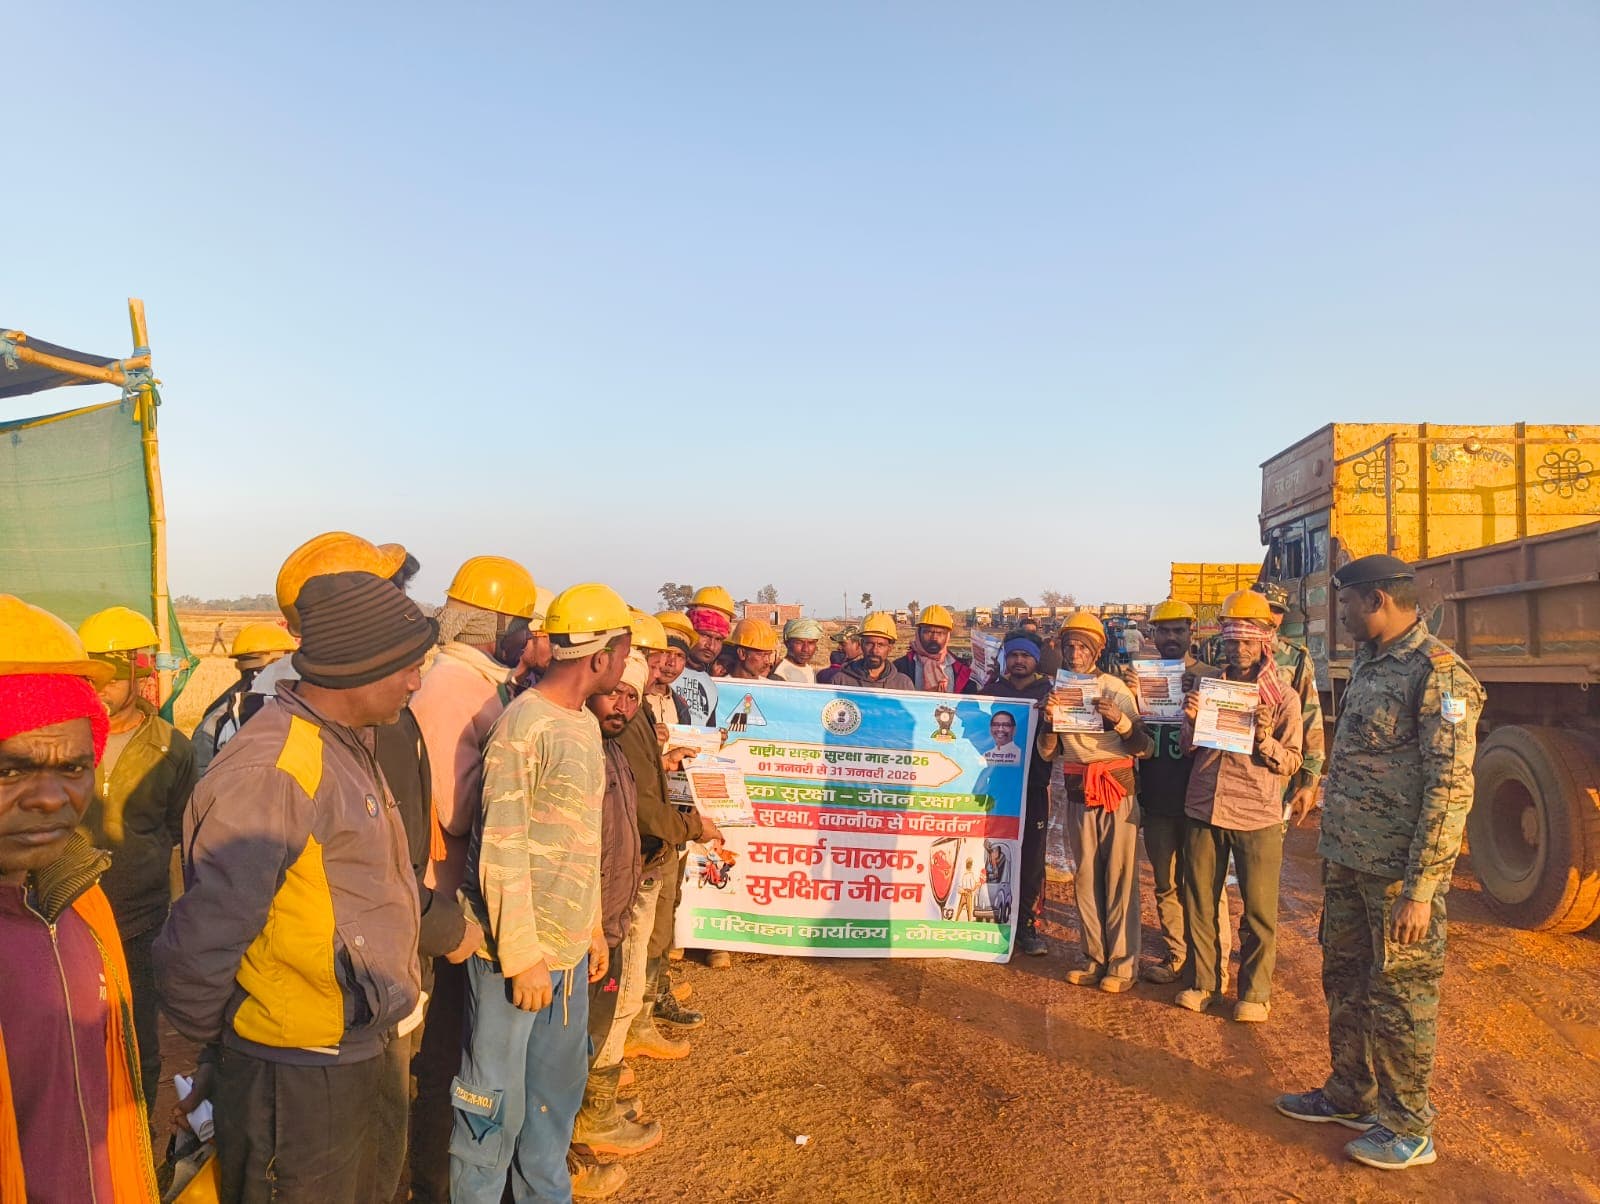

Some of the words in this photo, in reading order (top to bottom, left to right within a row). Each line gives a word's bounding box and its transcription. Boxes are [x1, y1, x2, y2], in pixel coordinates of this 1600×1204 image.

[683, 677, 698, 689] THE
[748, 744, 786, 758] राष्ट्रीय
[789, 748, 822, 760] सड़क
[824, 750, 862, 763] सुरक्षा
[864, 751, 930, 766] माह-2026
[758, 761, 771, 771] 01
[774, 762, 813, 774] जनवरी
[816, 763, 828, 774] से
[830, 765, 843, 776] 31
[845, 766, 884, 778] जनवरी
[887, 770, 917, 780] 2026
[780, 786, 836, 803] सुरक्षा
[858, 788, 915, 807] जीवन
[758, 808, 814, 826] सुरक्षा,
[818, 811, 882, 829] तकनीक
[887, 813, 903, 829] से
[748, 838, 826, 865] सतर्क
[830, 847, 924, 873] चालक,
[745, 870, 842, 905] सुरक्षित
[847, 874, 925, 902] जीवन
[710, 914, 794, 938] परिवहन
[798, 922, 887, 939] कार्यालय
[905, 923, 1001, 944] लोहरदगा
